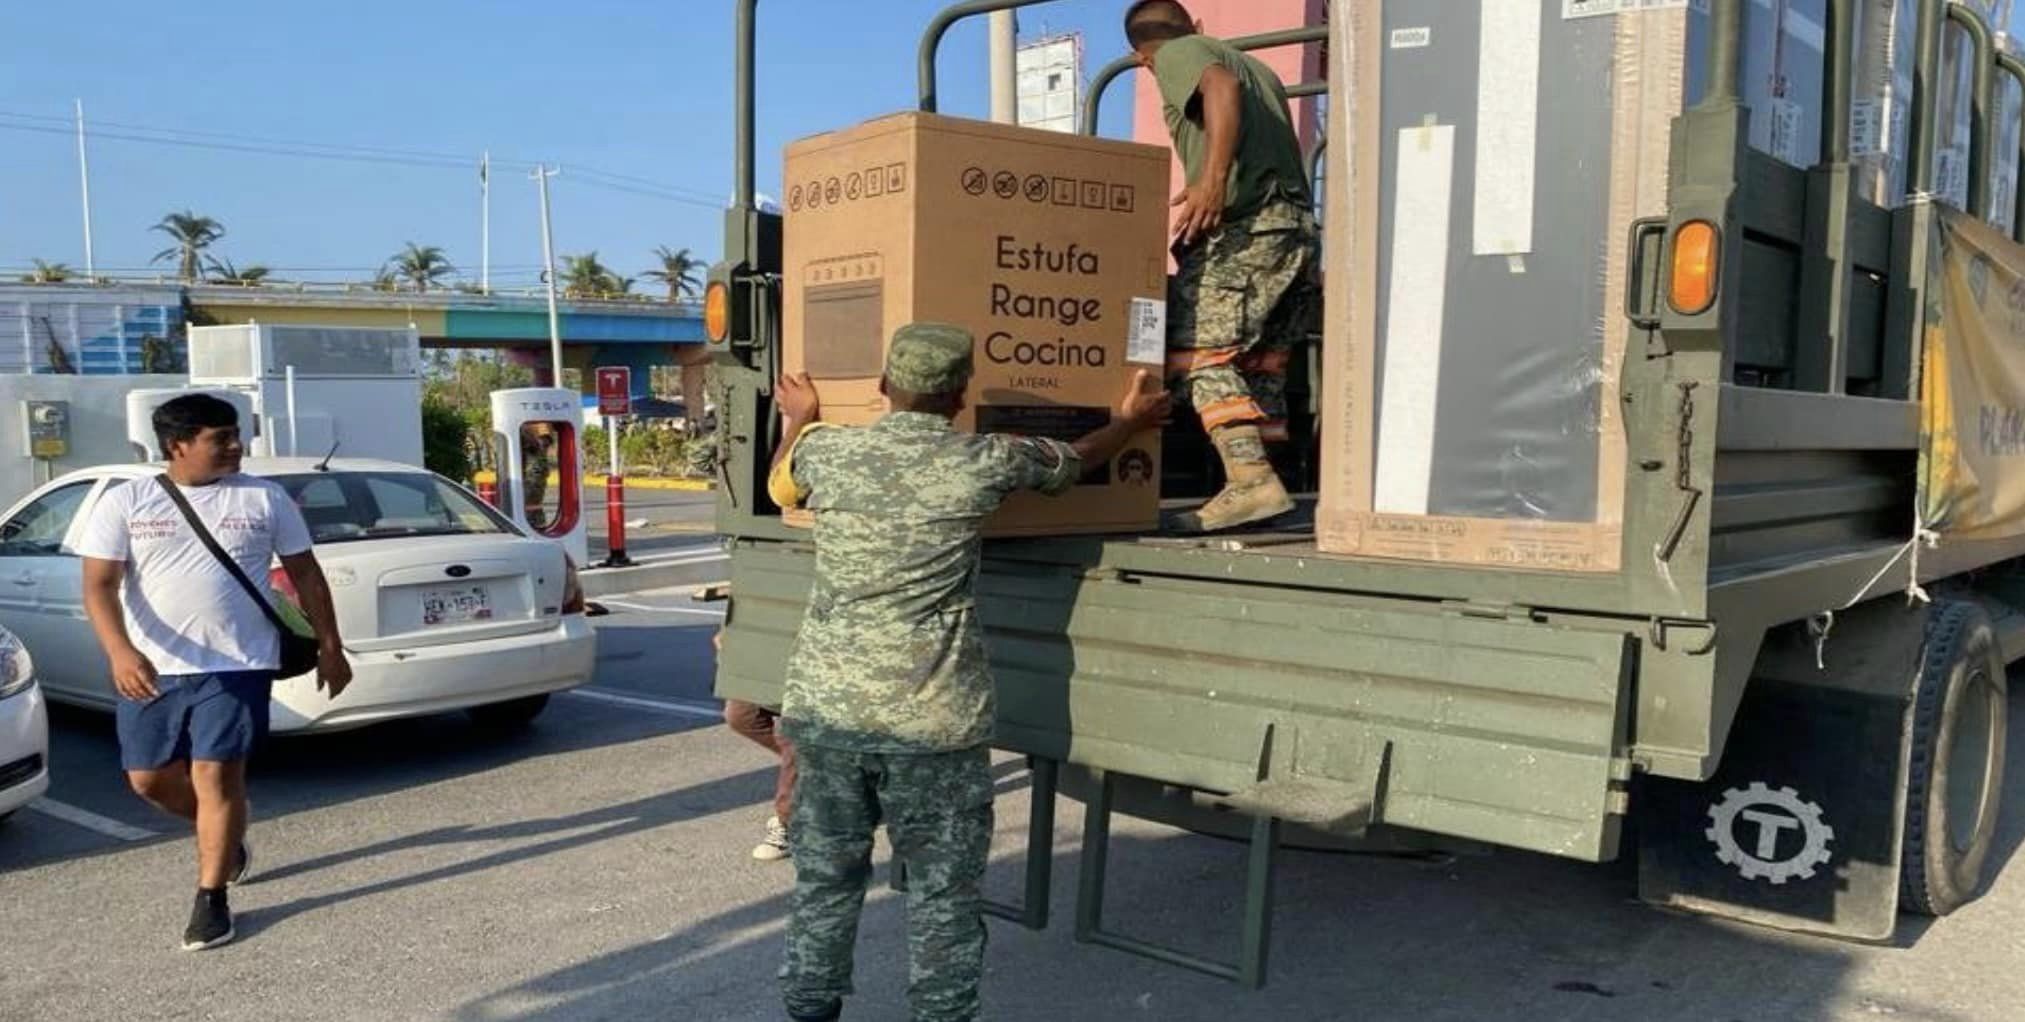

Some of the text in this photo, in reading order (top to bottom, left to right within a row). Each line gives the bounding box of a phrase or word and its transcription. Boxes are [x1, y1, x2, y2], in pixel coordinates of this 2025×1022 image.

[996, 235, 1099, 275] Estufa
[990, 283, 1102, 326] Range
[984, 331, 1107, 369] Cocina
[1009, 375, 1061, 390] LATERAL
[519, 401, 570, 412] TESLA
[1742, 808, 1800, 861] T
